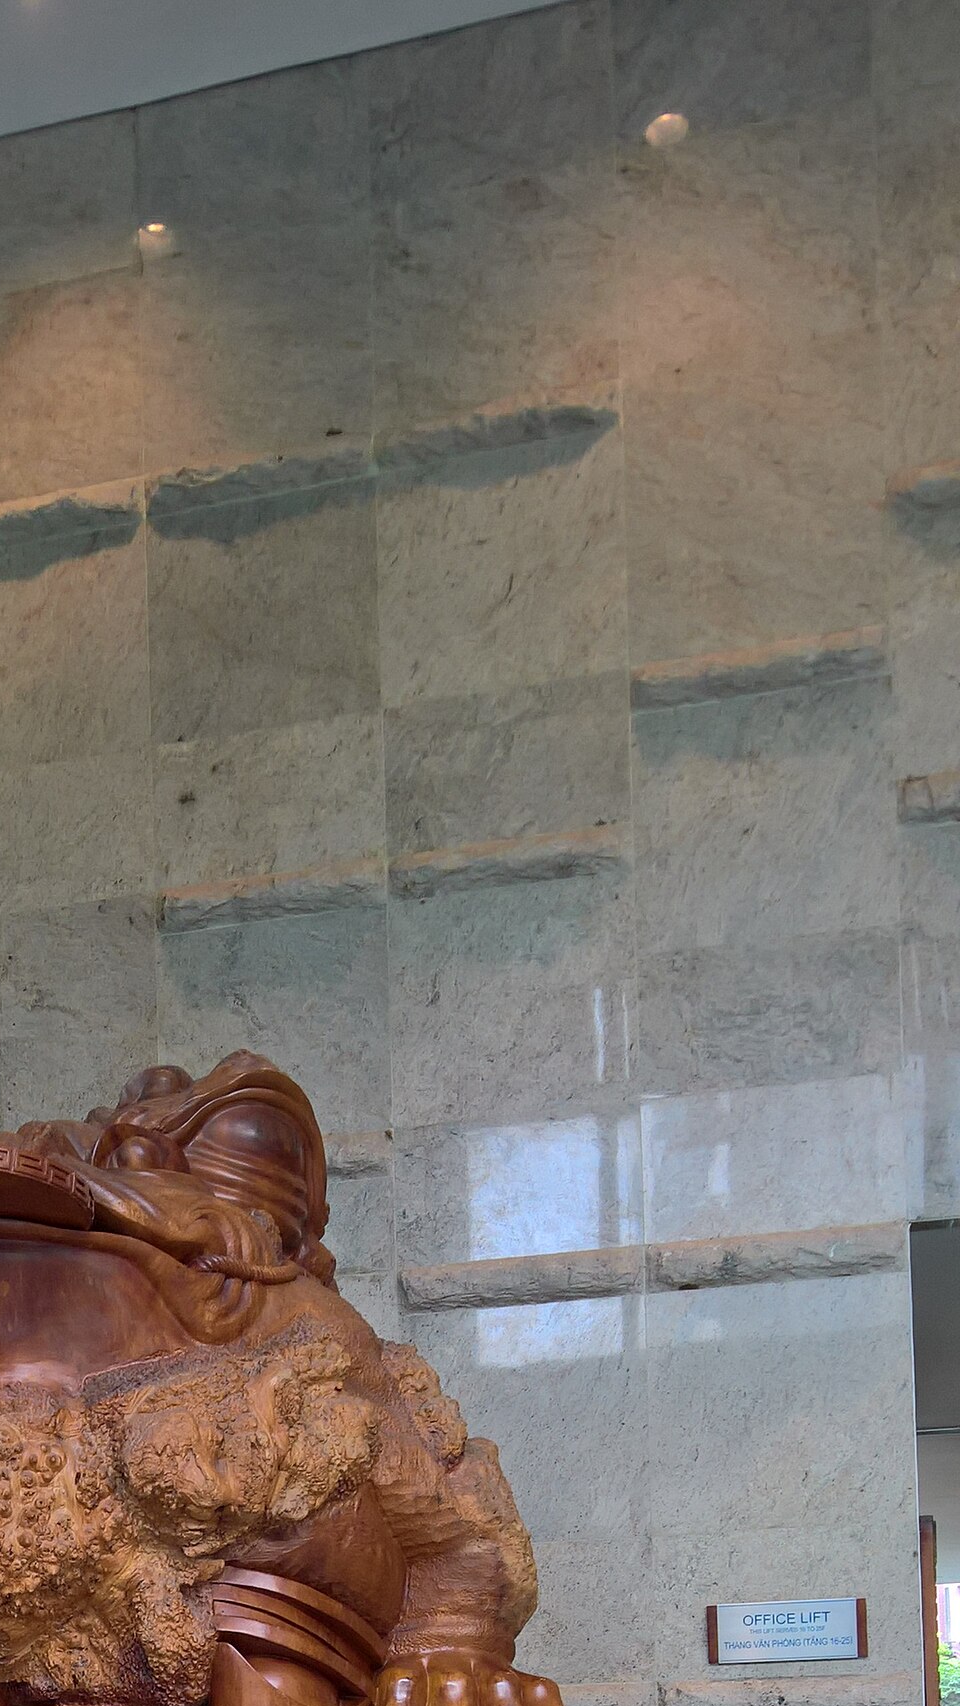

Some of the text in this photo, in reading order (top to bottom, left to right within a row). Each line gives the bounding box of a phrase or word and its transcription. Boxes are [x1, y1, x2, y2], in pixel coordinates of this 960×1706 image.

[742, 1611, 831, 1627] OFFICE LIFT
[724, 1640, 752, 1650] THANG
